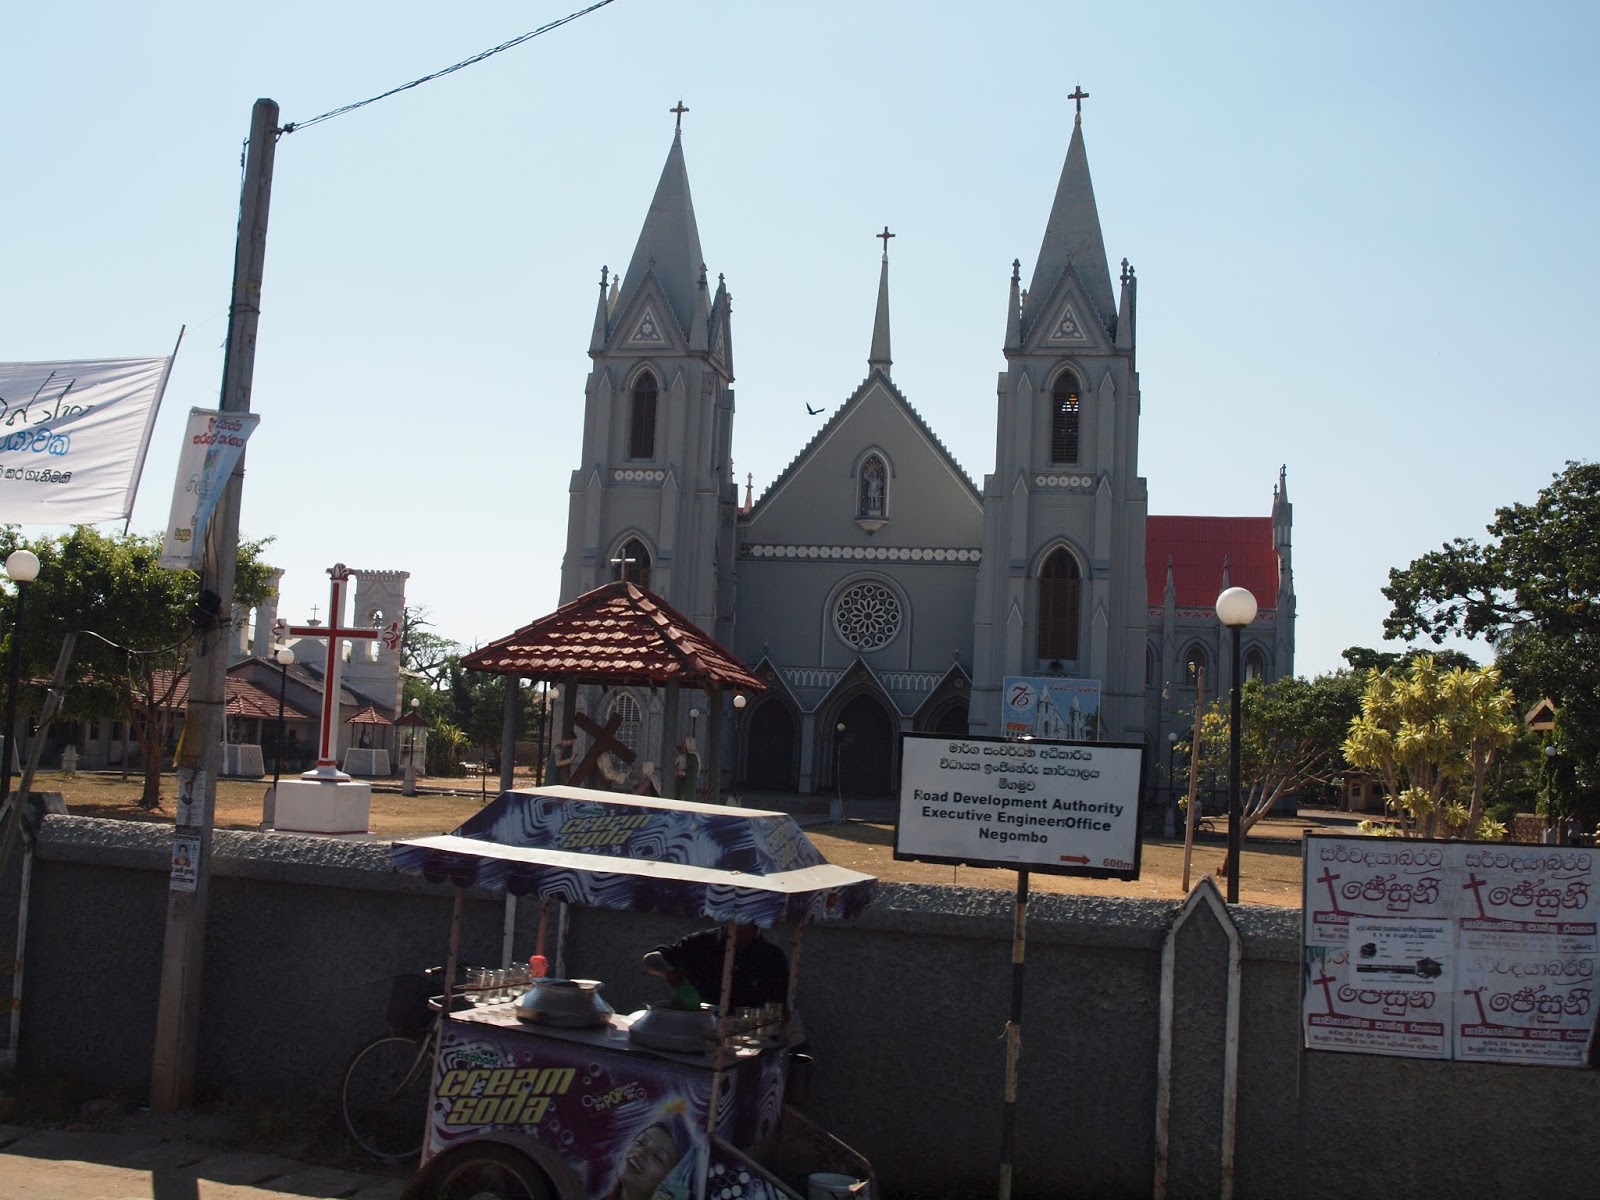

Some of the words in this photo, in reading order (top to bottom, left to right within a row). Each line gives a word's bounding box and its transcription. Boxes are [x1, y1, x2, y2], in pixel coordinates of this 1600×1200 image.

[1010, 686, 1034, 709] 75
[914, 789, 948, 802] Road
[953, 792, 1047, 809] Development
[1052, 799, 1124, 817] Authority
[560, 814, 654, 833] cream
[922, 806, 992, 822] Executive
[1066, 818, 1112, 832] Office
[562, 828, 634, 848] soda
[979, 827, 1048, 844] Negombo
[1103, 858, 1133, 870] 600m
[455, 1049, 499, 1067] Elephant
[437, 1067, 576, 1096] cream
[446, 1090, 551, 1125] soda
